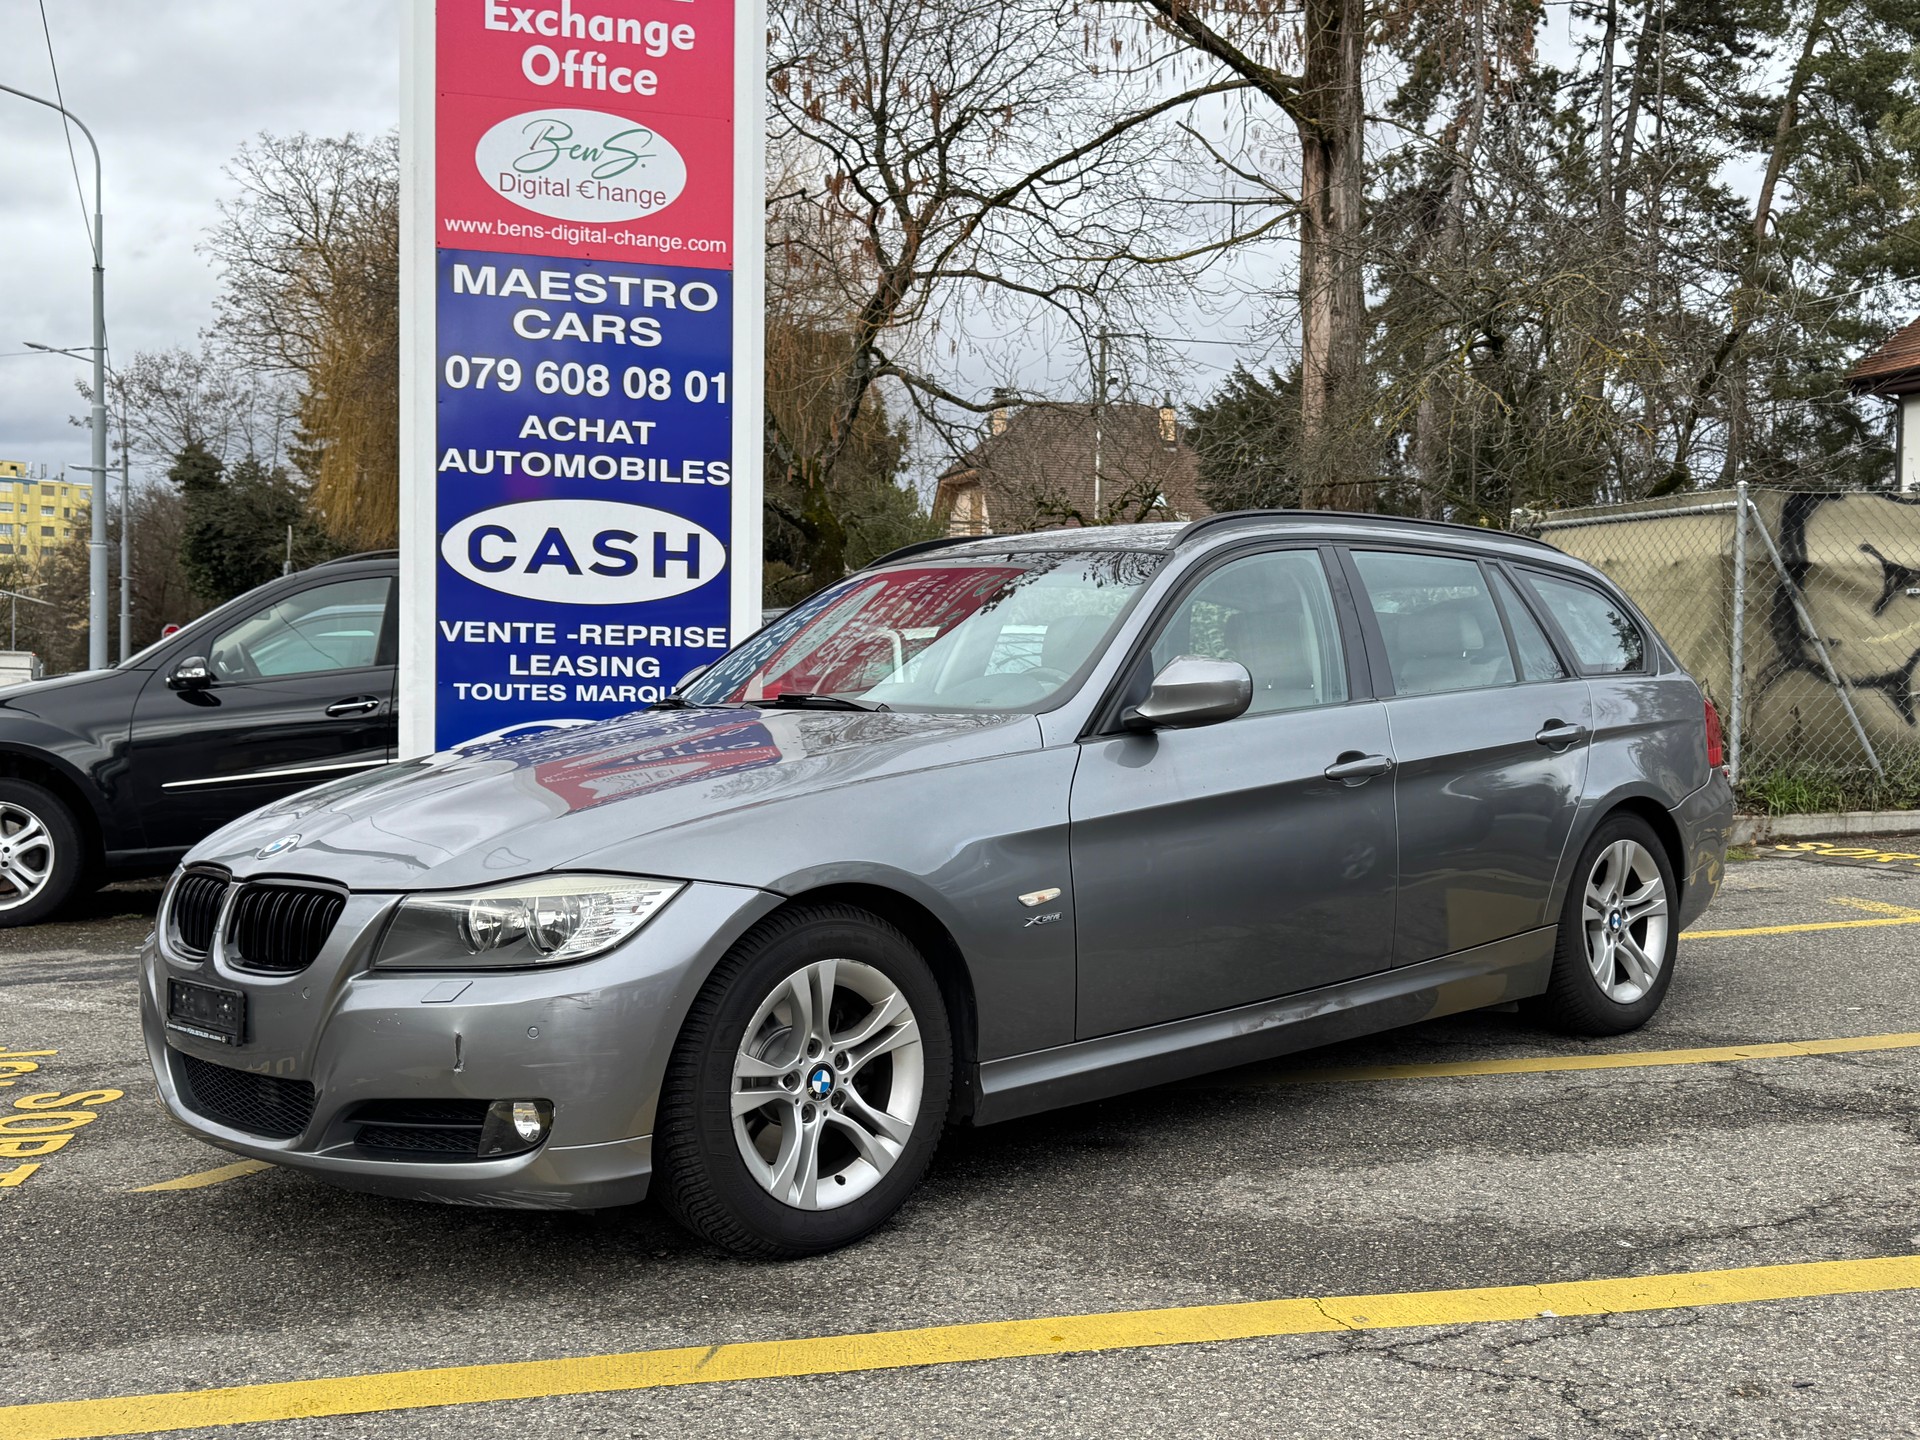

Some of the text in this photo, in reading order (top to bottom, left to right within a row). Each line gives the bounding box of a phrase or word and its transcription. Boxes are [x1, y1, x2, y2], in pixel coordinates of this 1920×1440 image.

[485, 0, 695, 58] Exchange
[521, 44, 659, 96] Office
[499, 172, 570, 200] Digital
[444, 217, 727, 253] www.bens-digital-change.com
[453, 263, 719, 312] MAESTRO
[512, 309, 663, 347] CARS
[444, 354, 726, 404] 079 608 08 01
[518, 414, 657, 445] ACHAT
[437, 448, 731, 486] AUTOMOBILES
[467, 524, 700, 580] CASH
[439, 620, 557, 644] VENTE
[509, 654, 660, 679] LEASING
[452, 682, 567, 702] TOUTES
